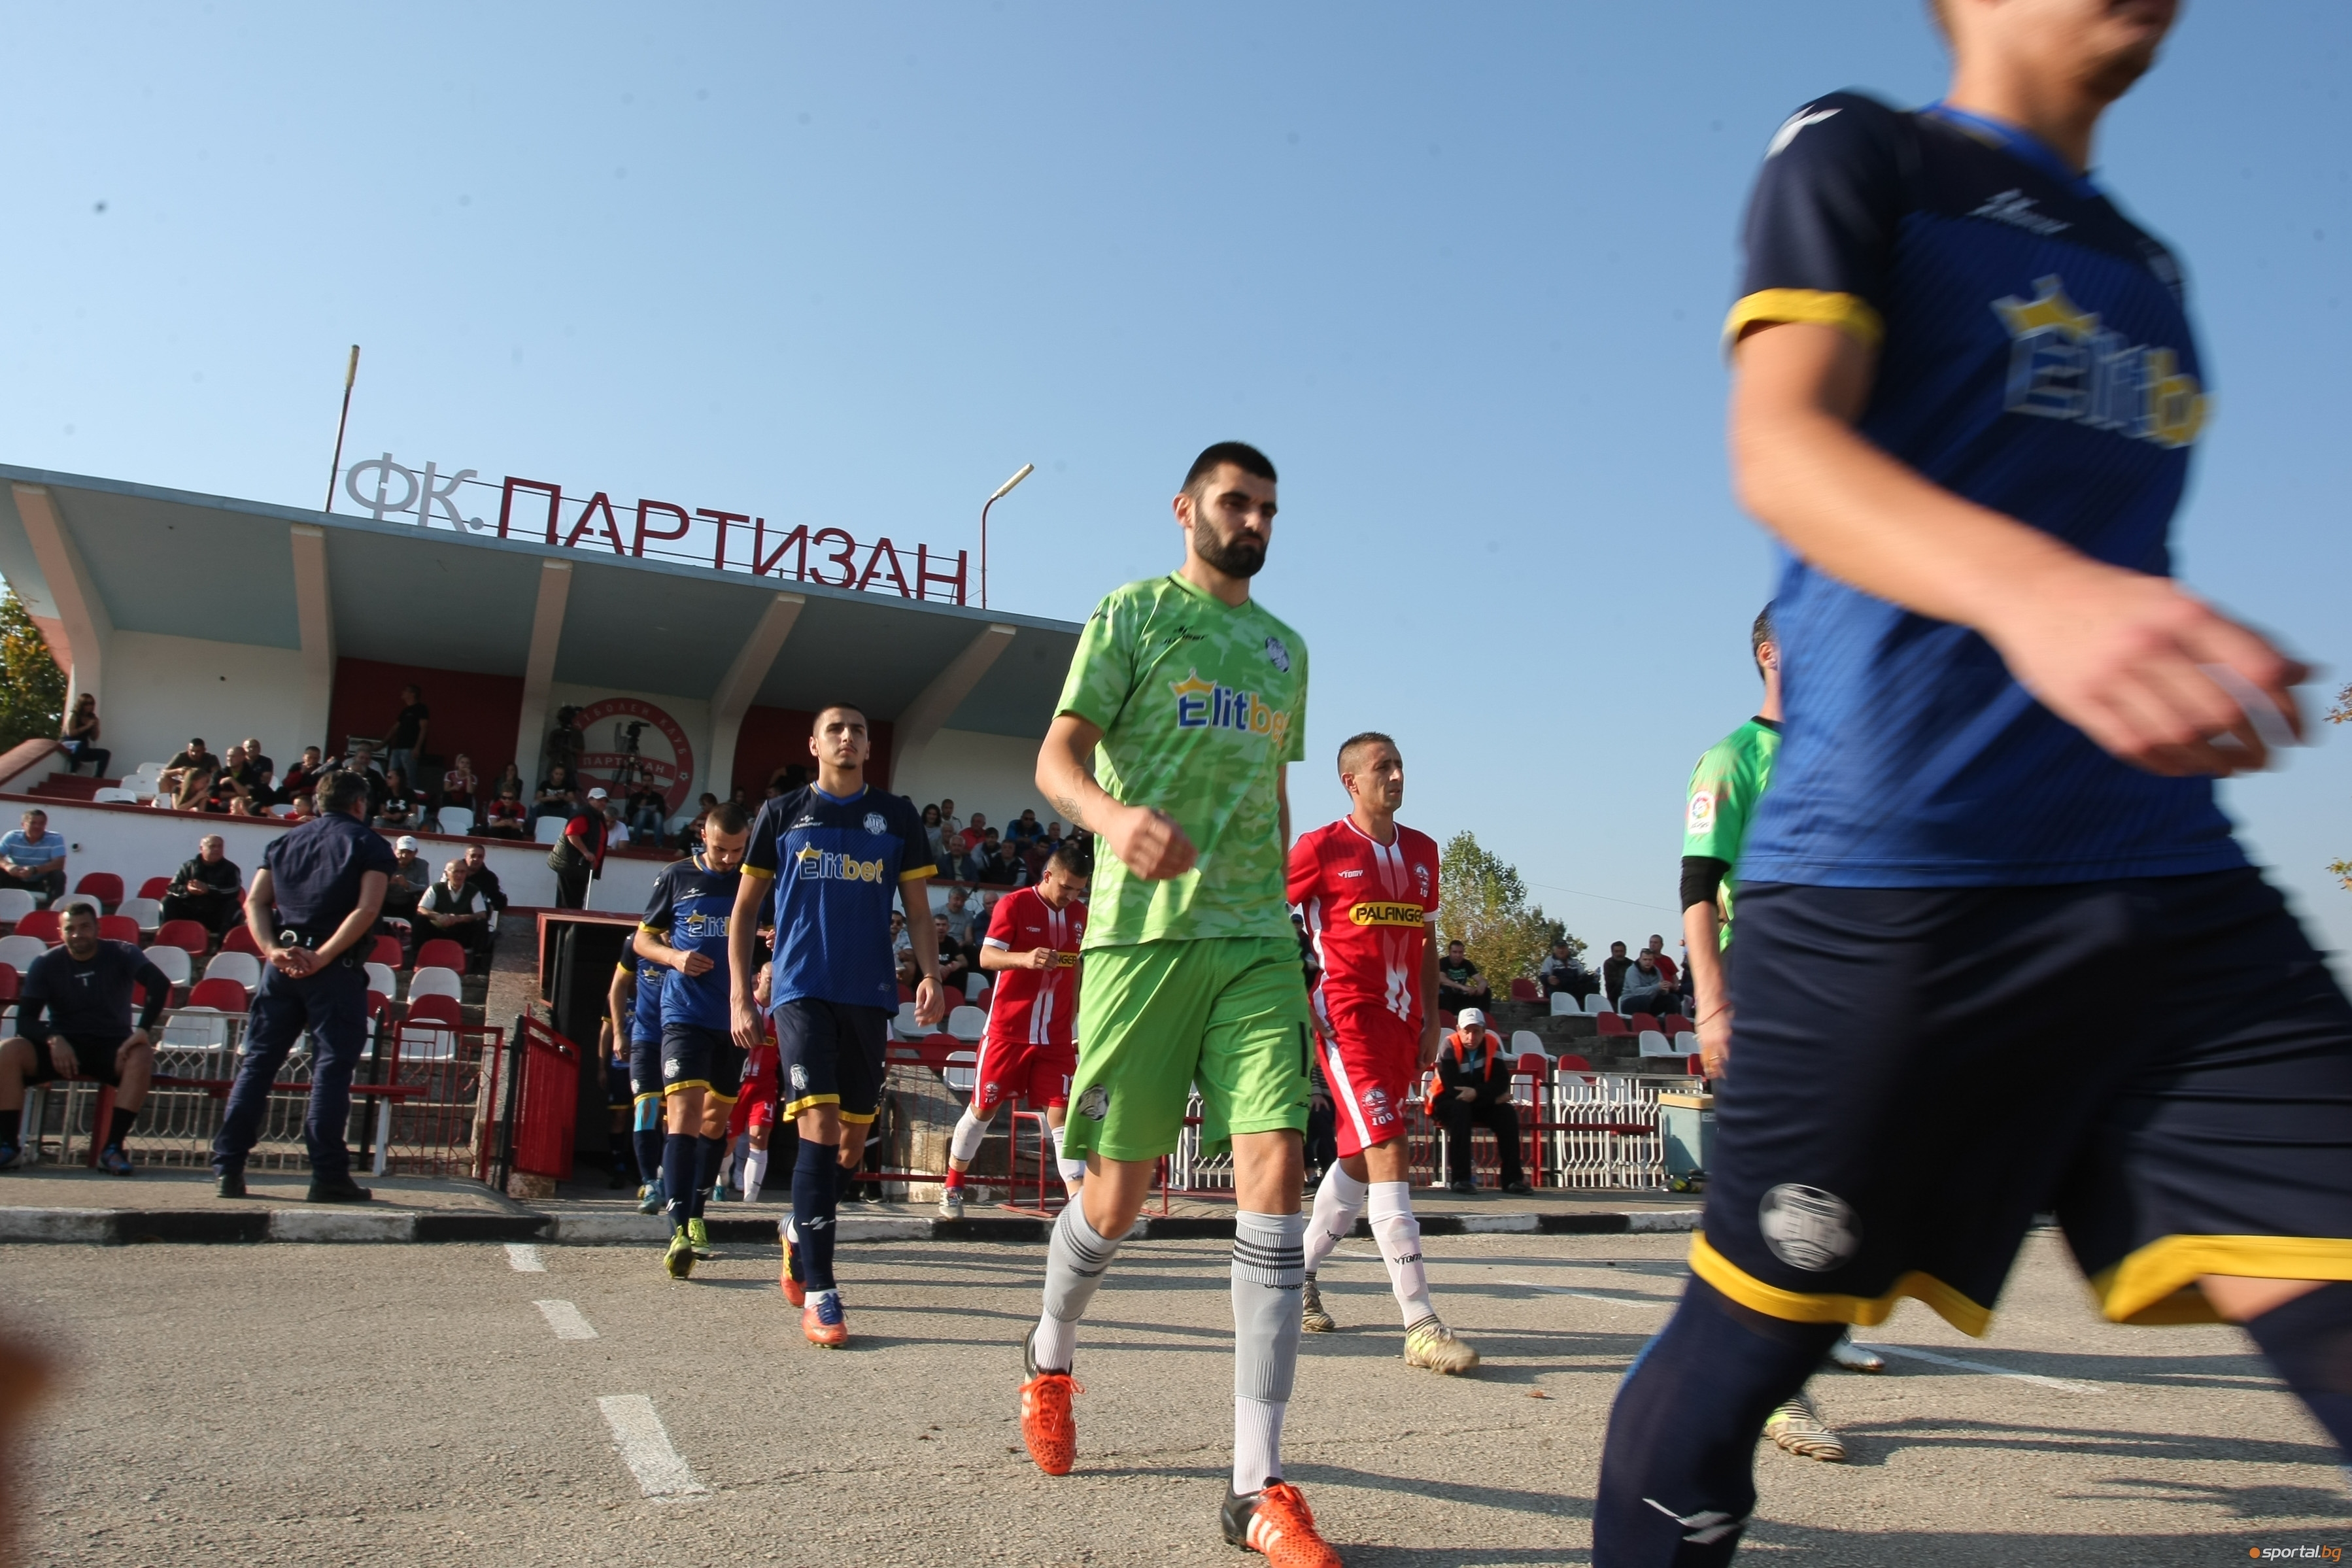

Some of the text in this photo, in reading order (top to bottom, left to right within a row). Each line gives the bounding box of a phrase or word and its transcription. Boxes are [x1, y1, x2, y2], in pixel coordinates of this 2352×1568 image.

[498, 475, 967, 605] ПАРТИЗАН
[583, 757, 666, 774] ПАРТАН
[799, 852, 883, 883] Elitbet
[1372, 1113, 1394, 1125] 100
